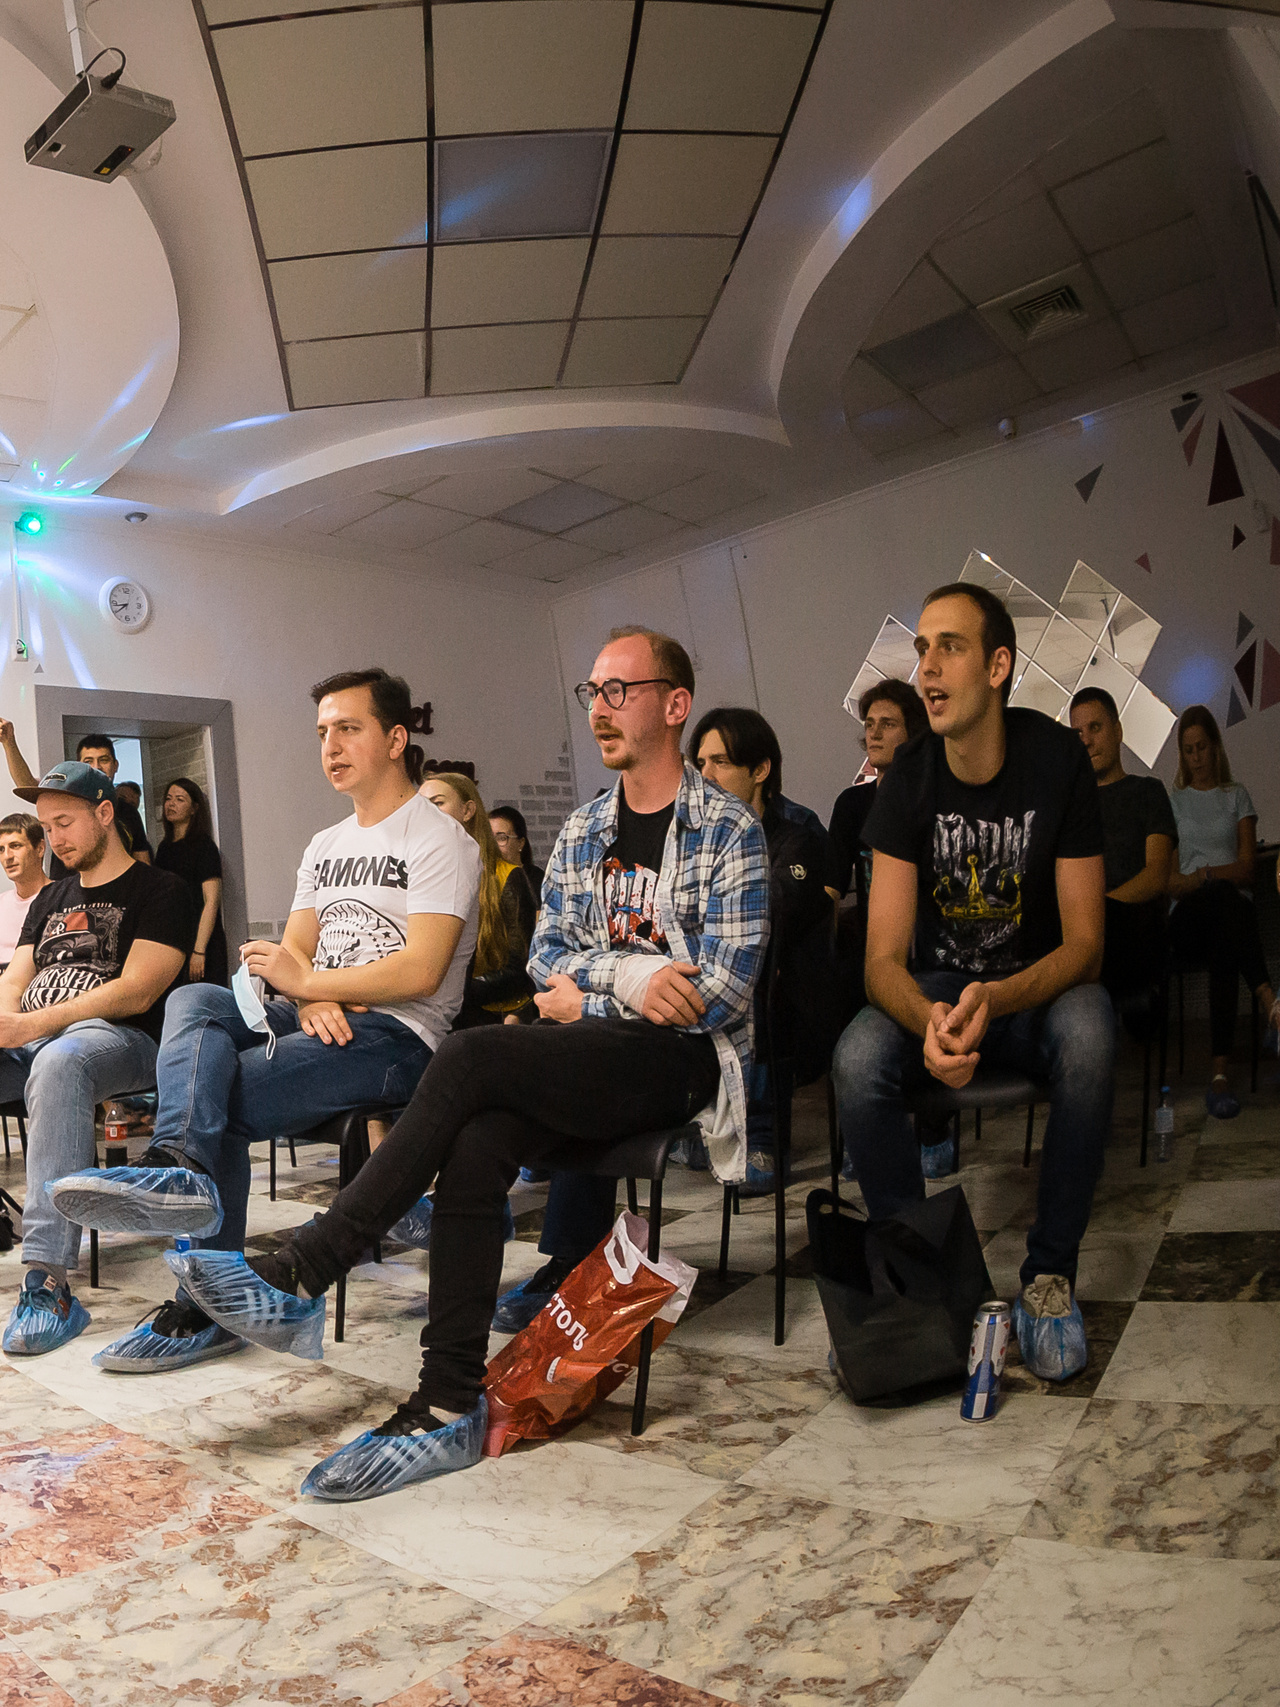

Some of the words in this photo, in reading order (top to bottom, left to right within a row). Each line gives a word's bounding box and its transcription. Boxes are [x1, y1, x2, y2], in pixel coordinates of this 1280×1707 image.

[122, 587, 130, 595] 12
[136, 602, 142, 610] 3
[124, 614, 131, 622] 6
